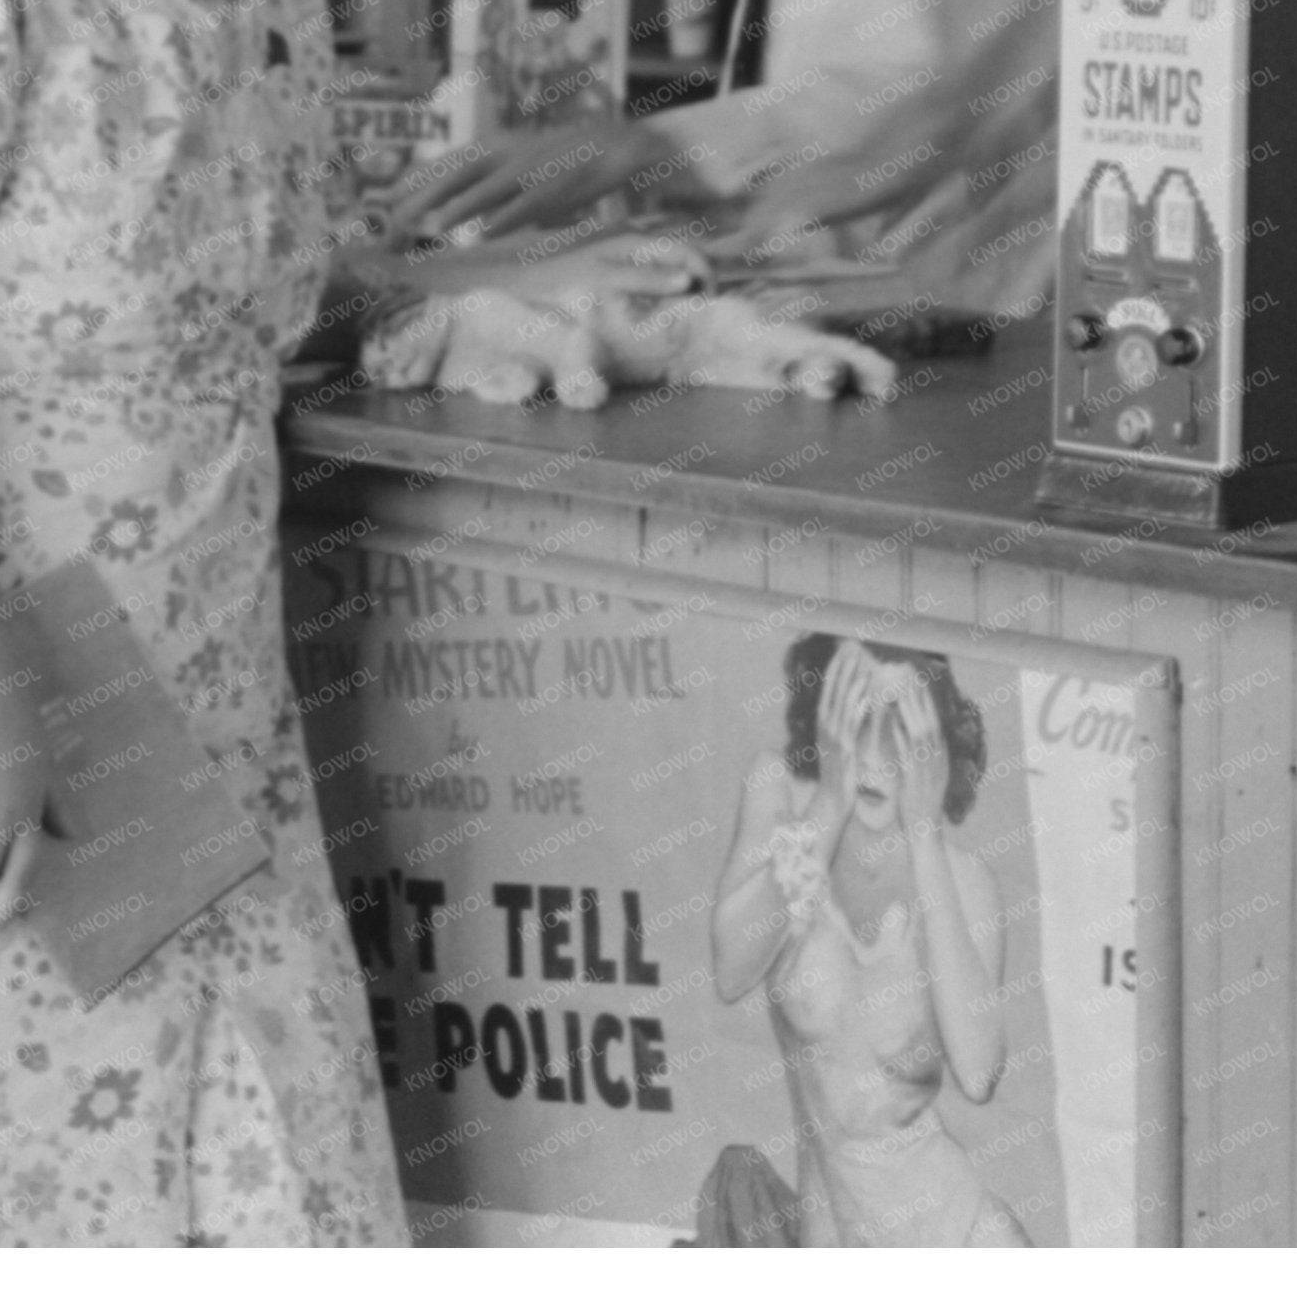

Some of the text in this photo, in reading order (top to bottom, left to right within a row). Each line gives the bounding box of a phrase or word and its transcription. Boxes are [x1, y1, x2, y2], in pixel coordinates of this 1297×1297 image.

[1125, 31, 1189, 56] POSTAGE
[1082, 60, 1204, 128] STAMPS
[308, 550, 665, 621] STARTL
[382, 639, 541, 701] MYSTERY
[563, 635, 686, 701] NOVEL
[447, 718, 479, 763] by
[376, 773, 586, 817] EDWARD HOPE
[491, 882, 662, 988] TELL
[434, 999, 675, 1115] POLICE
